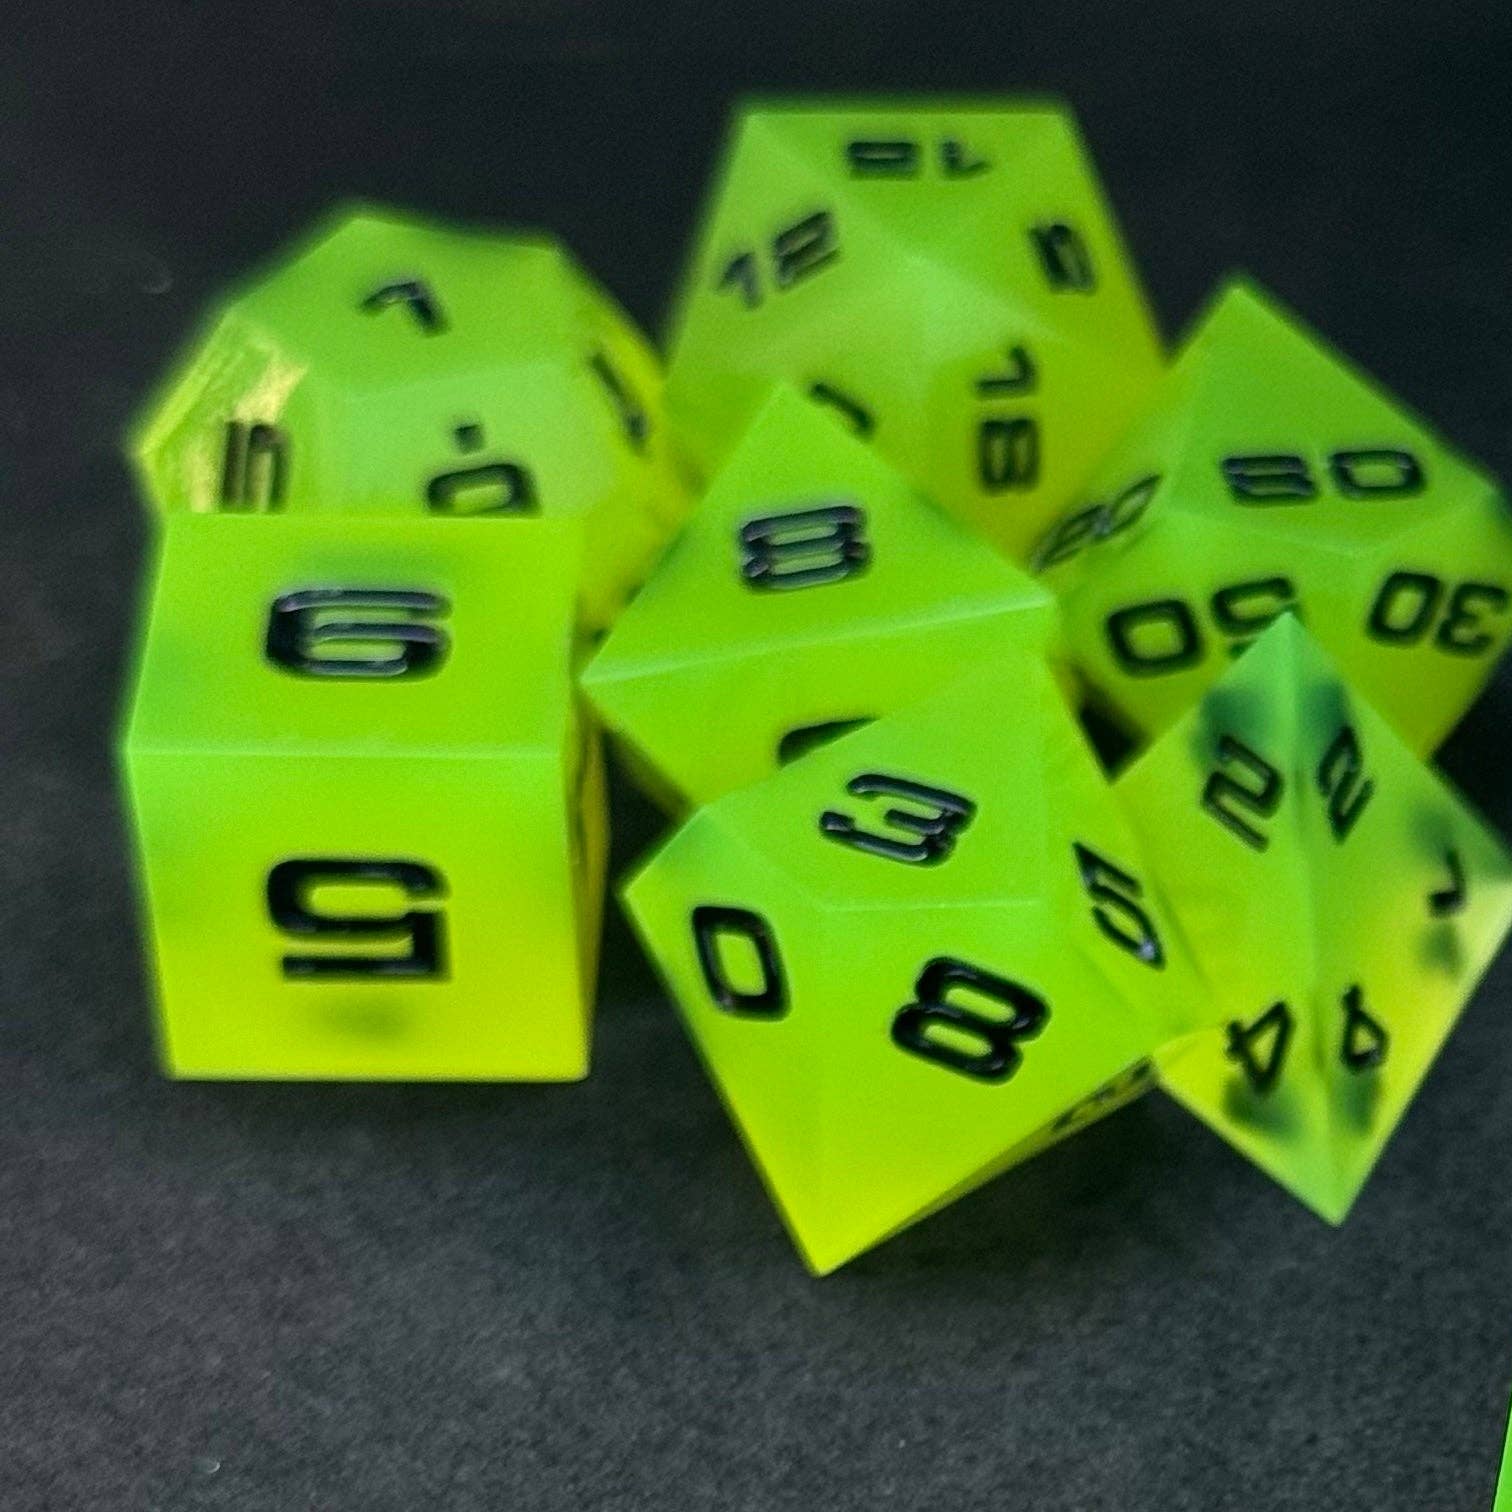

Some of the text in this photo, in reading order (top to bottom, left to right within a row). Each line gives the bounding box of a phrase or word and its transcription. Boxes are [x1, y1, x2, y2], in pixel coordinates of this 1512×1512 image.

[740, 505, 873, 593] 8
[266, 586, 452, 682] 6
[1367, 570, 1510, 658] 30
[820, 774, 977, 867] 3
[1202, 735, 1282, 852] 2
[1317, 726, 1374, 845] 2
[266, 858, 450, 982] 5
[691, 905, 792, 1022] 0
[891, 956, 1052, 1085] 8
[1224, 1000, 1296, 1094] 4
[1342, 984, 1389, 1073] 4
